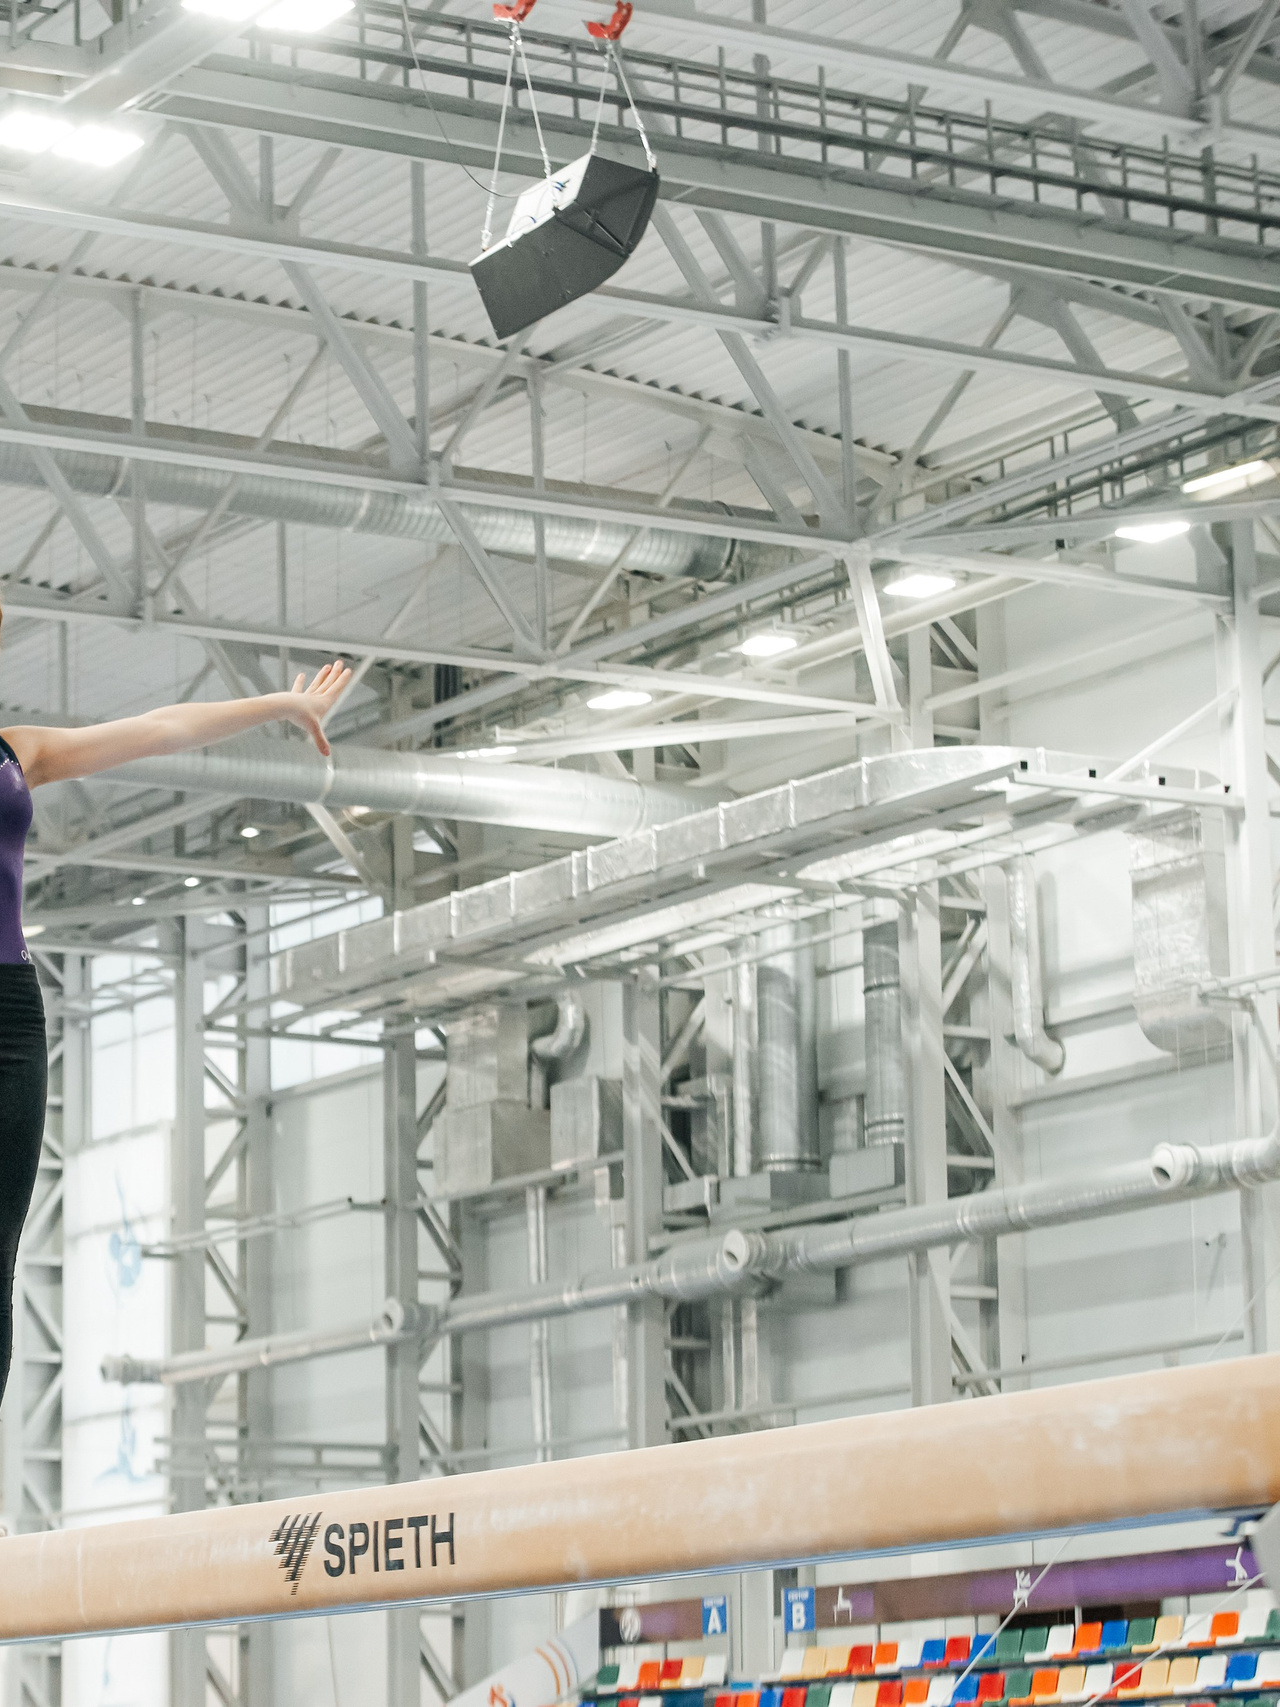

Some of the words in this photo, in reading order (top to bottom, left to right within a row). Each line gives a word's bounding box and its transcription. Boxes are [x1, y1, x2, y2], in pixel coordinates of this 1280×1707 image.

[324, 1512, 455, 1577] SPIETH
[707, 1606, 722, 1635] A
[791, 1602, 806, 1631] B
